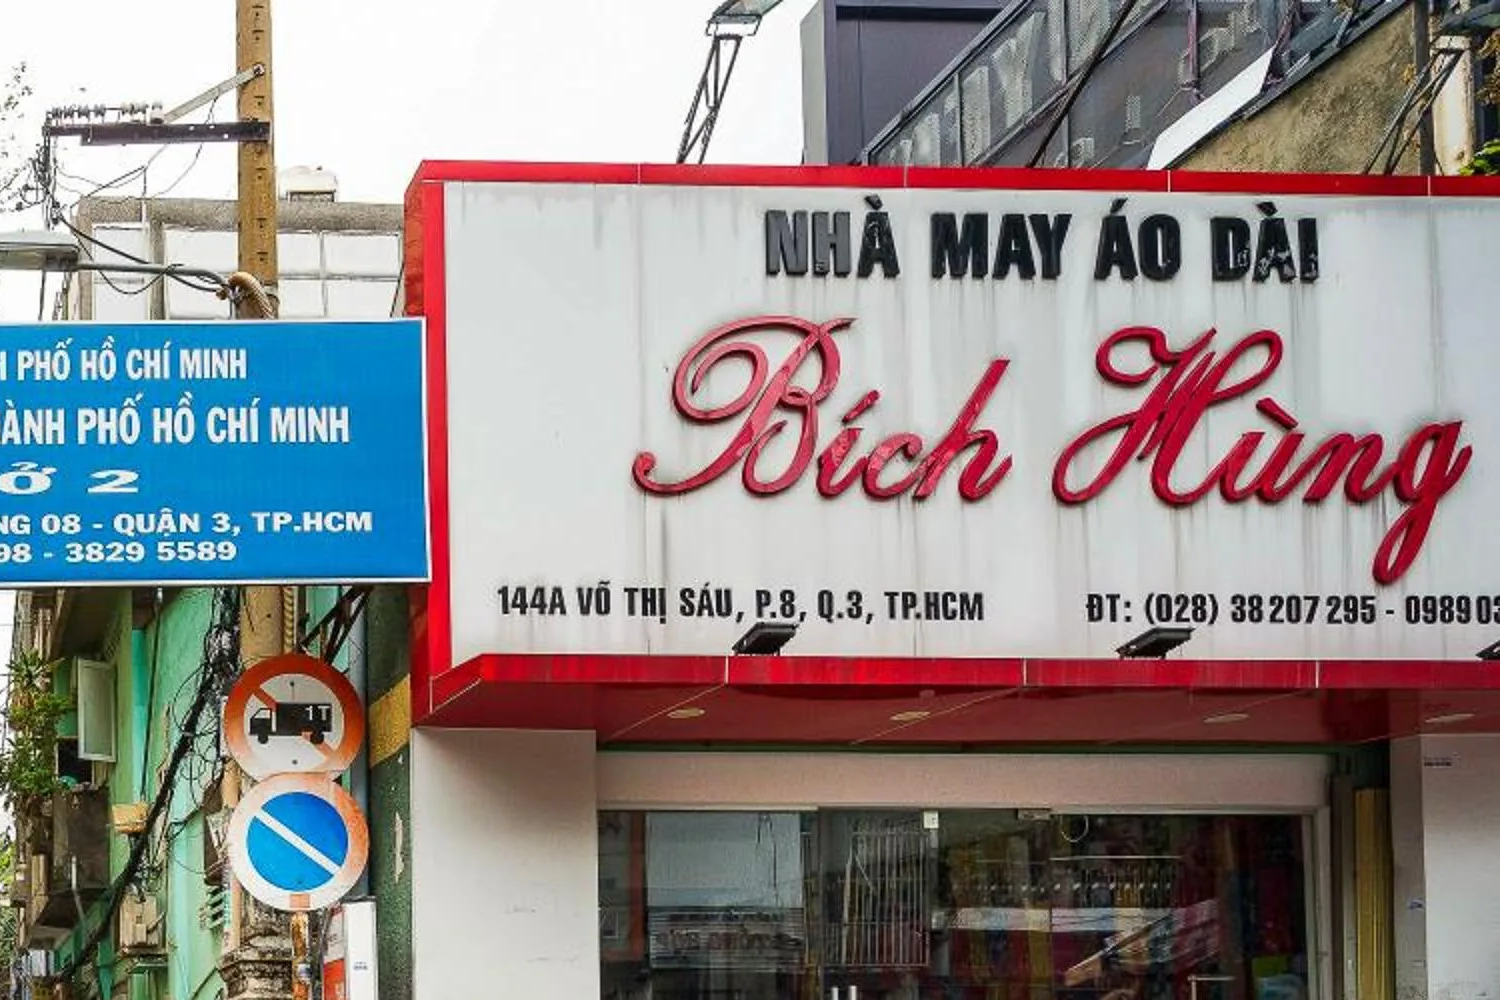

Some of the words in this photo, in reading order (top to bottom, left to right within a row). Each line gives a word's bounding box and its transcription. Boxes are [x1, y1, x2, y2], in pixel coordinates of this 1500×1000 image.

[765, 195, 900, 279] NHÀ
[930, 212, 1072, 281] MAY
[1094, 197, 1182, 282] ÁO
[1210, 201, 1320, 284] DÀI
[17, 337, 73, 381] PHỐ
[80, 336, 117, 381] HỒ
[126, 341, 171, 380] CHÍ
[179, 348, 247, 379] MINH
[77, 392, 143, 445] PHỐ
[152, 391, 195, 444] HỒ
[206, 398, 260, 443] CHÍ
[270, 406, 350, 443] MINH
[632, 315, 1013, 501] Bích
[1052, 326, 1473, 585] Hùng
[87, 469, 140, 493] 2
[41, 513, 81, 535] 08
[113, 508, 200, 537] QUẬN
[211, 512, 241, 537] 3,
[251, 511, 373, 533] TP.HCM
[66, 542, 145, 563] 3829
[157, 541, 237, 562] 5589
[497, 585, 567, 616] 144A
[577, 580, 611, 617] VÕ
[624, 587, 667, 625] THỊ
[679, 582, 744, 623] SÁU,
[755, 589, 806, 623] P.8,
[817, 589, 873, 624] Q.3,
[884, 591, 985, 621] TP.HCM
[1085, 593, 1132, 624] ĐT:
[1144, 593, 1219, 626] (028)
